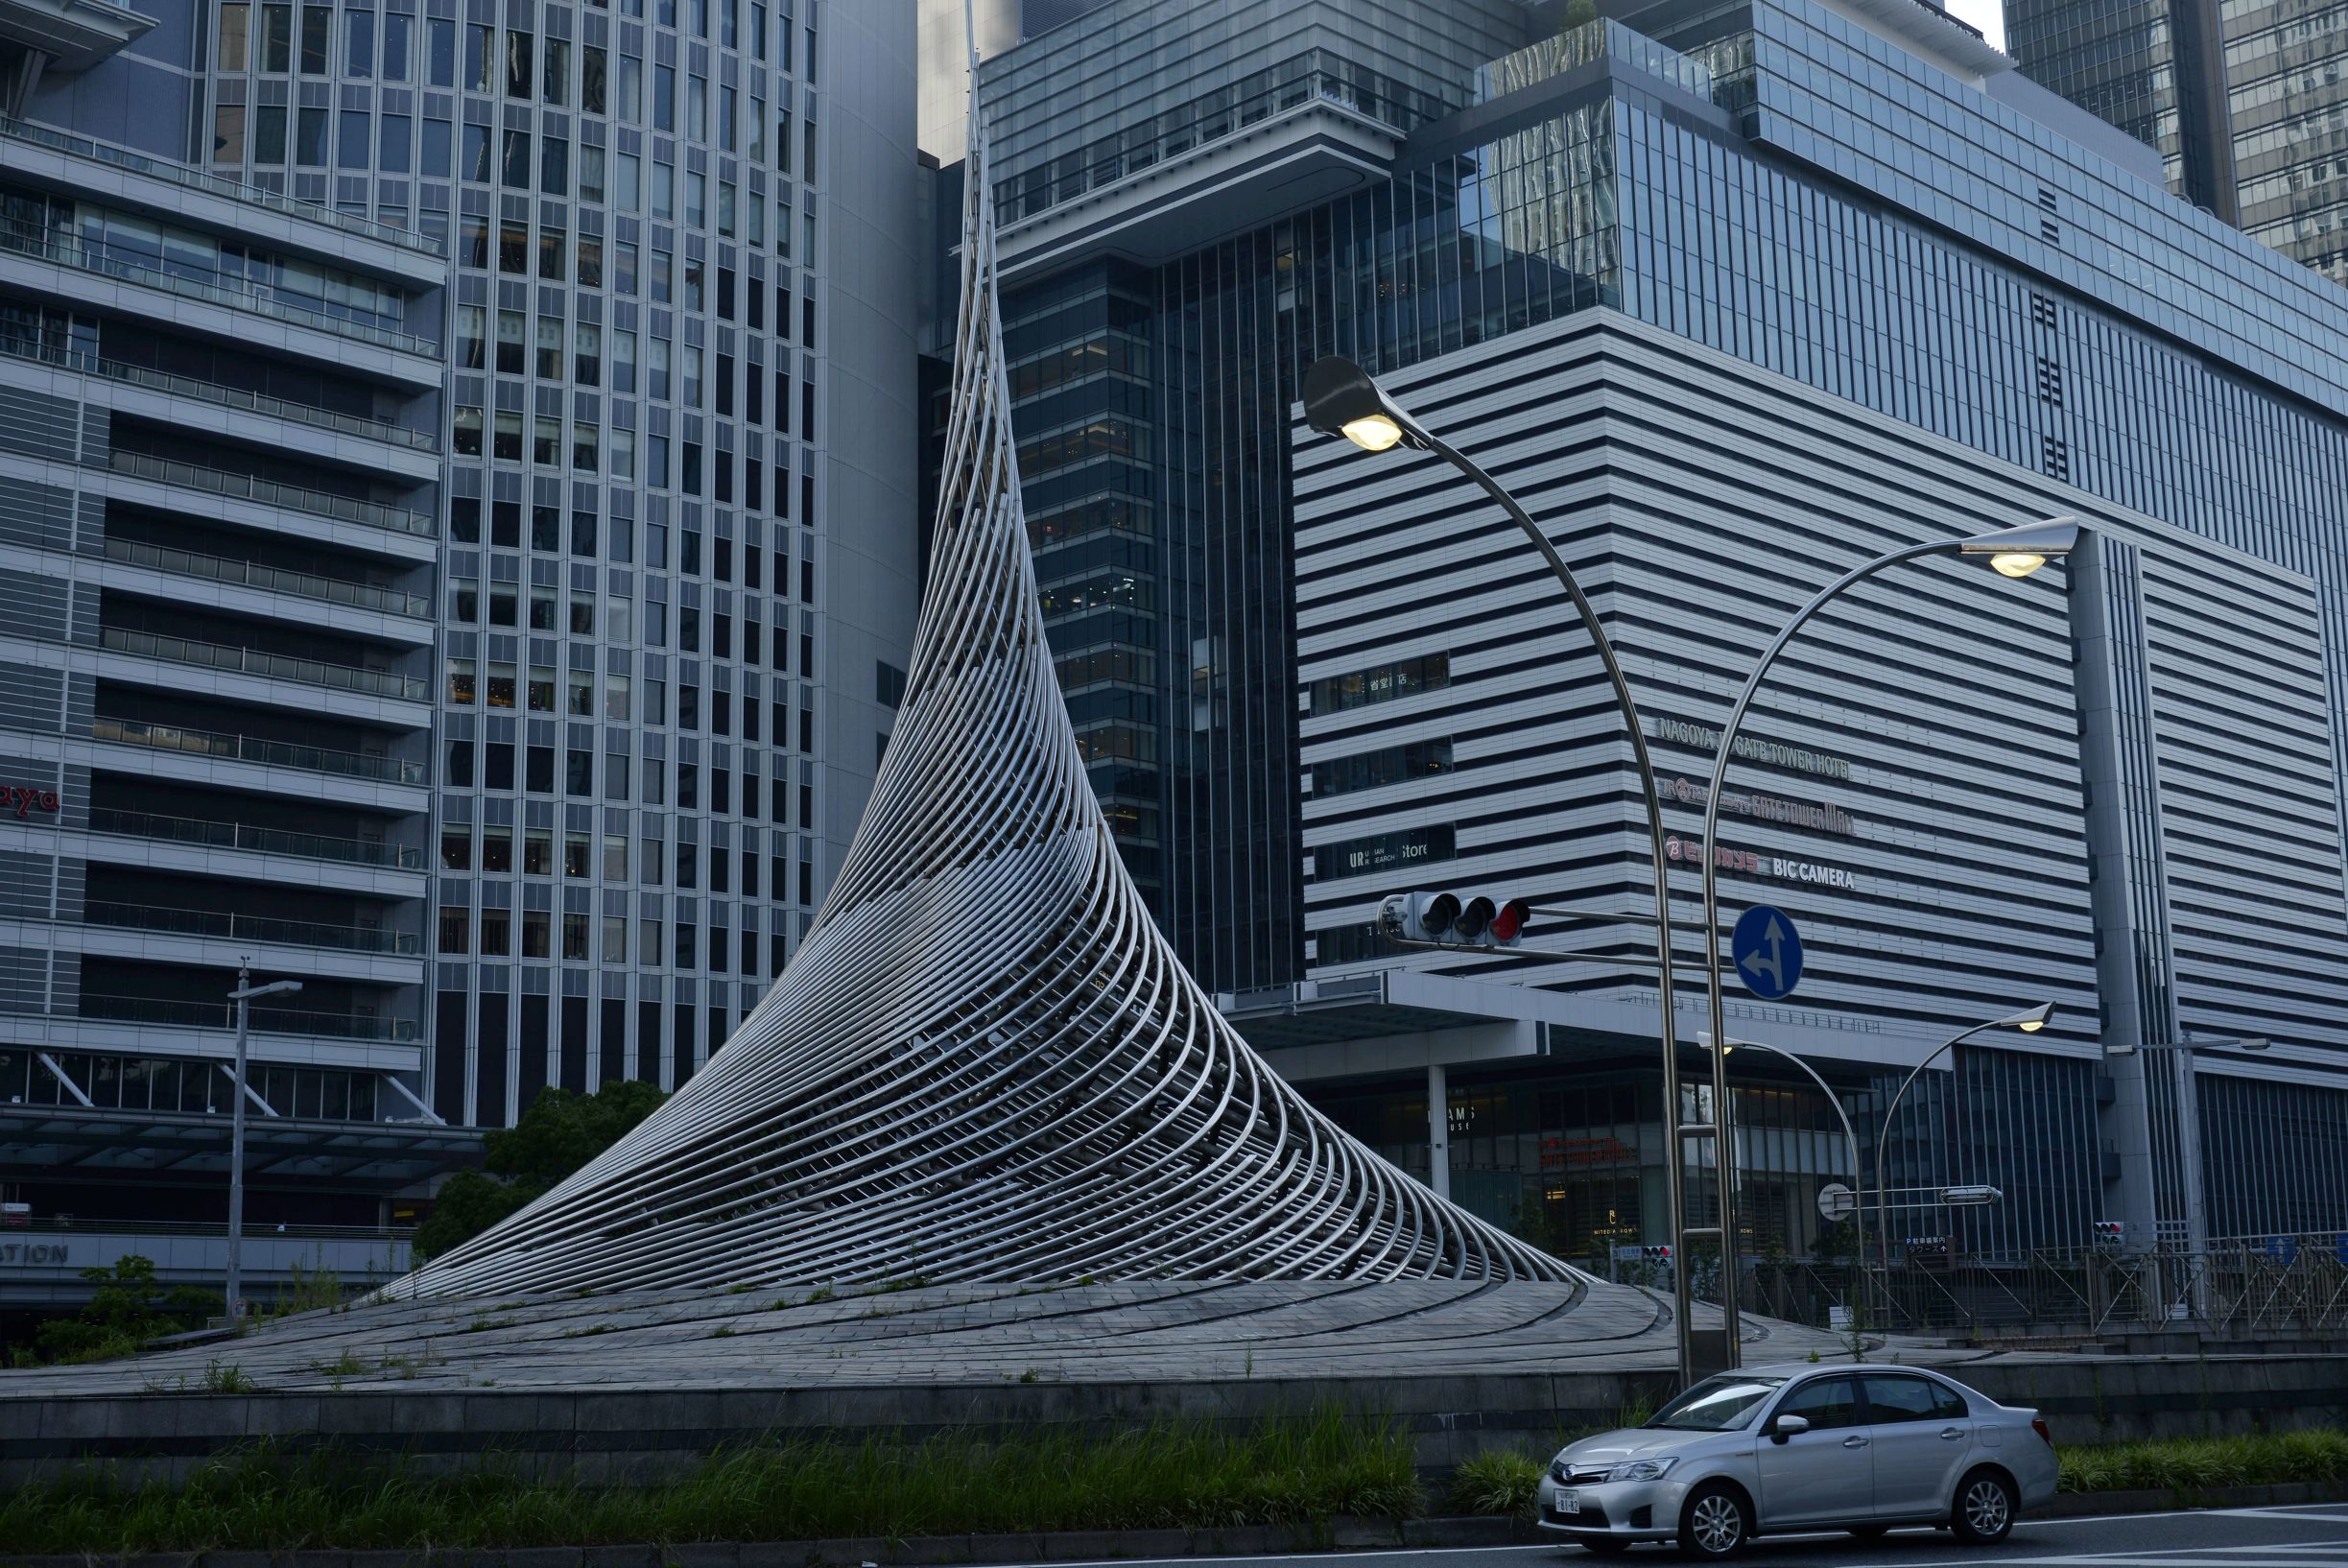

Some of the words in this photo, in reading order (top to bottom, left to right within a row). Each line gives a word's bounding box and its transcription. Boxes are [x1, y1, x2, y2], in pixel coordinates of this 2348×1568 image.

[1659, 718, 1714, 749] NAGOYA
[1735, 735, 1766, 761] GATE
[1769, 744, 1813, 772] TOWER
[1815, 754, 1853, 780] HOTEL
[1349, 851, 1364, 867] UR
[1773, 857, 1797, 879] BIC
[1798, 862, 1856, 890] CAMERA
